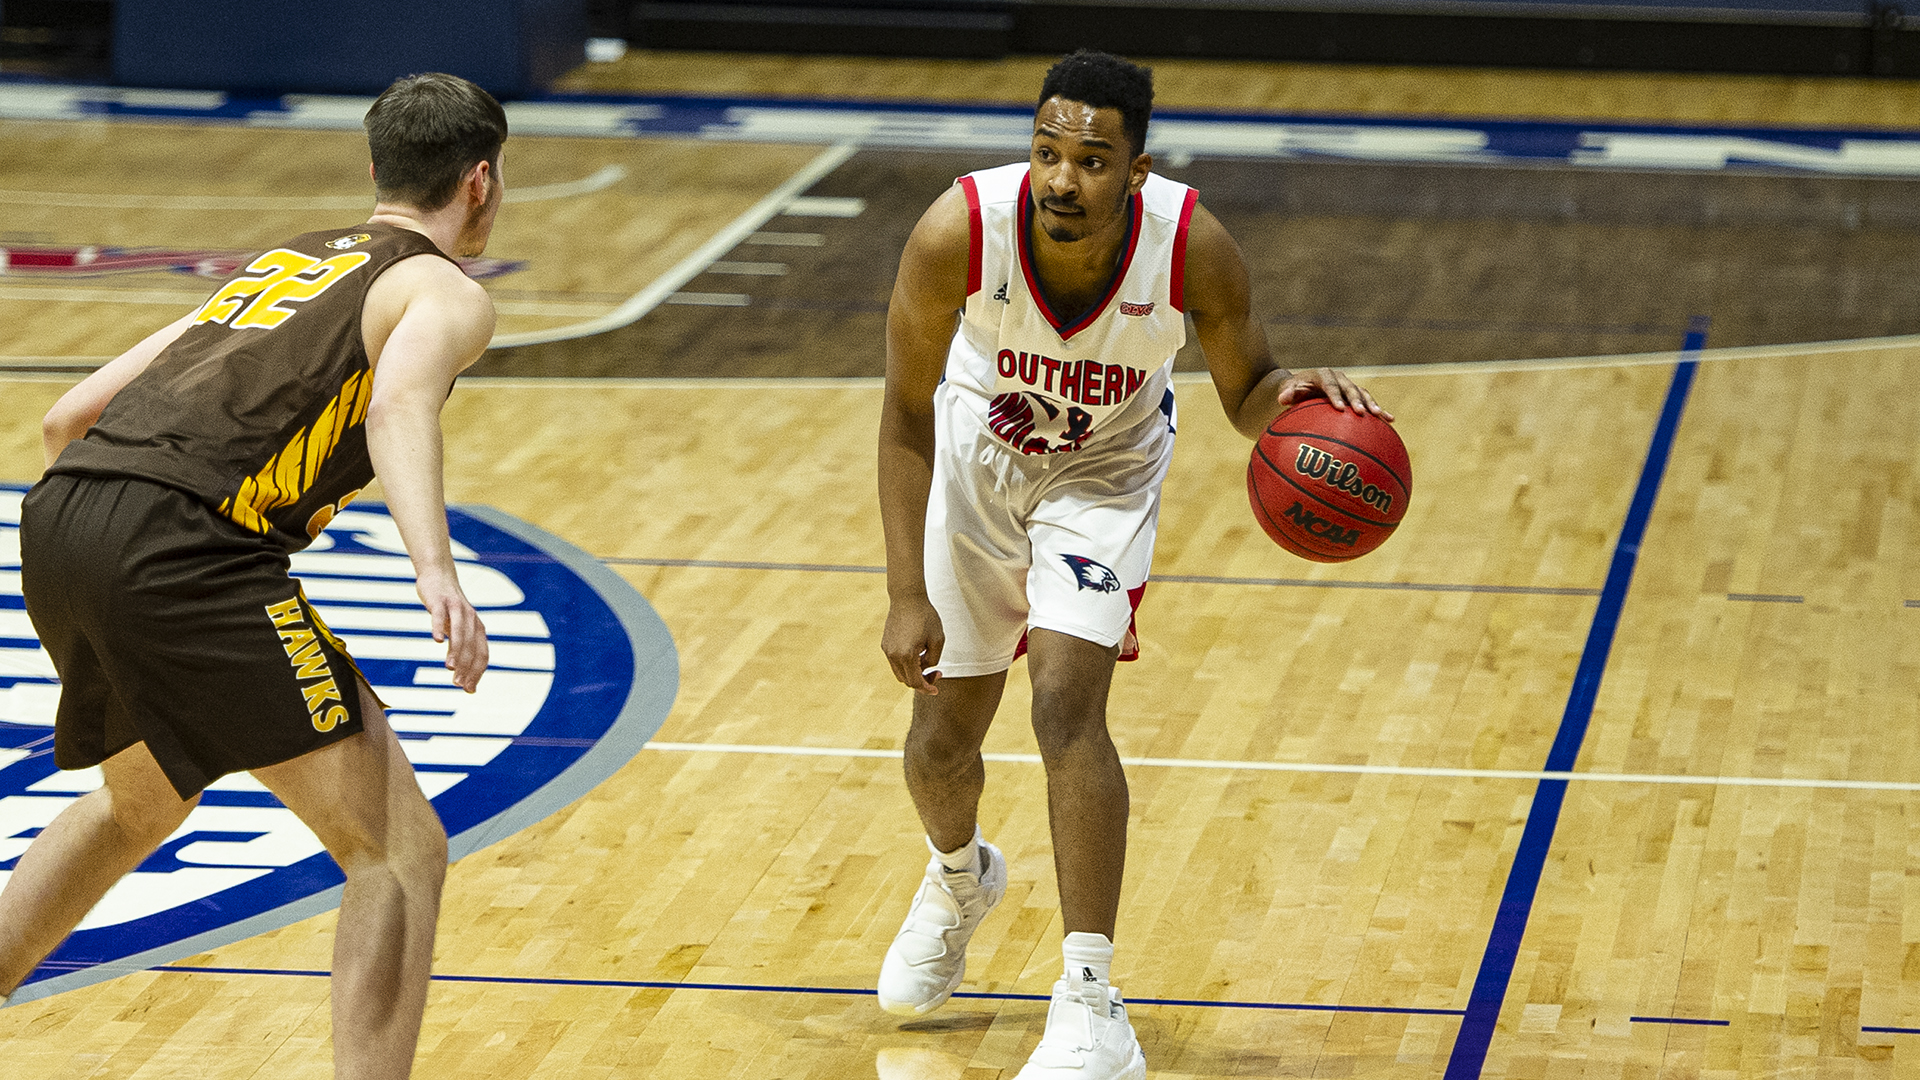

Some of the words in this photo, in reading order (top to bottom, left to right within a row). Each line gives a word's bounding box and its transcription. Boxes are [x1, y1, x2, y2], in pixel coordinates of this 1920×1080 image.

[188, 249, 372, 330] 22
[997, 348, 1147, 406] OUTHERN
[1295, 443, 1393, 514] Wilson
[1283, 501, 1361, 546] NCAA
[265, 596, 350, 733] HAWKS
